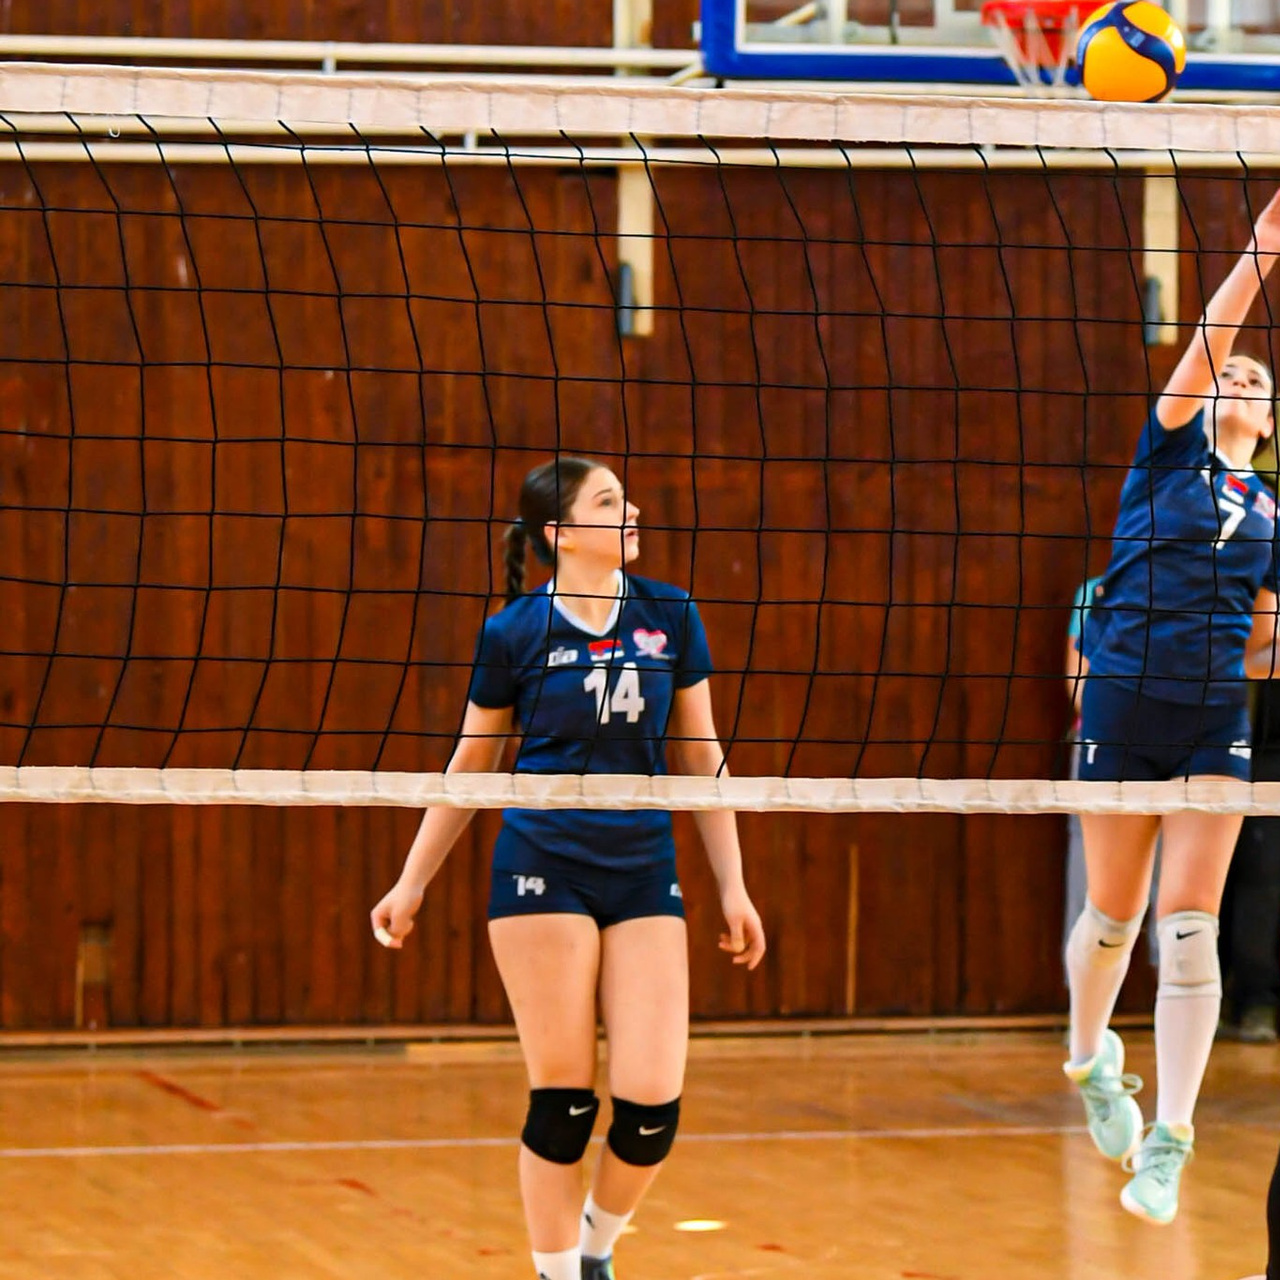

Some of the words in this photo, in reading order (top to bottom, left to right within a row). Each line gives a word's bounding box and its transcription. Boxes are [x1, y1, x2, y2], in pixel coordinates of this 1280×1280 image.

[1212, 498, 1246, 549] 7
[583, 662, 645, 724] 14
[513, 875, 546, 896] 14
